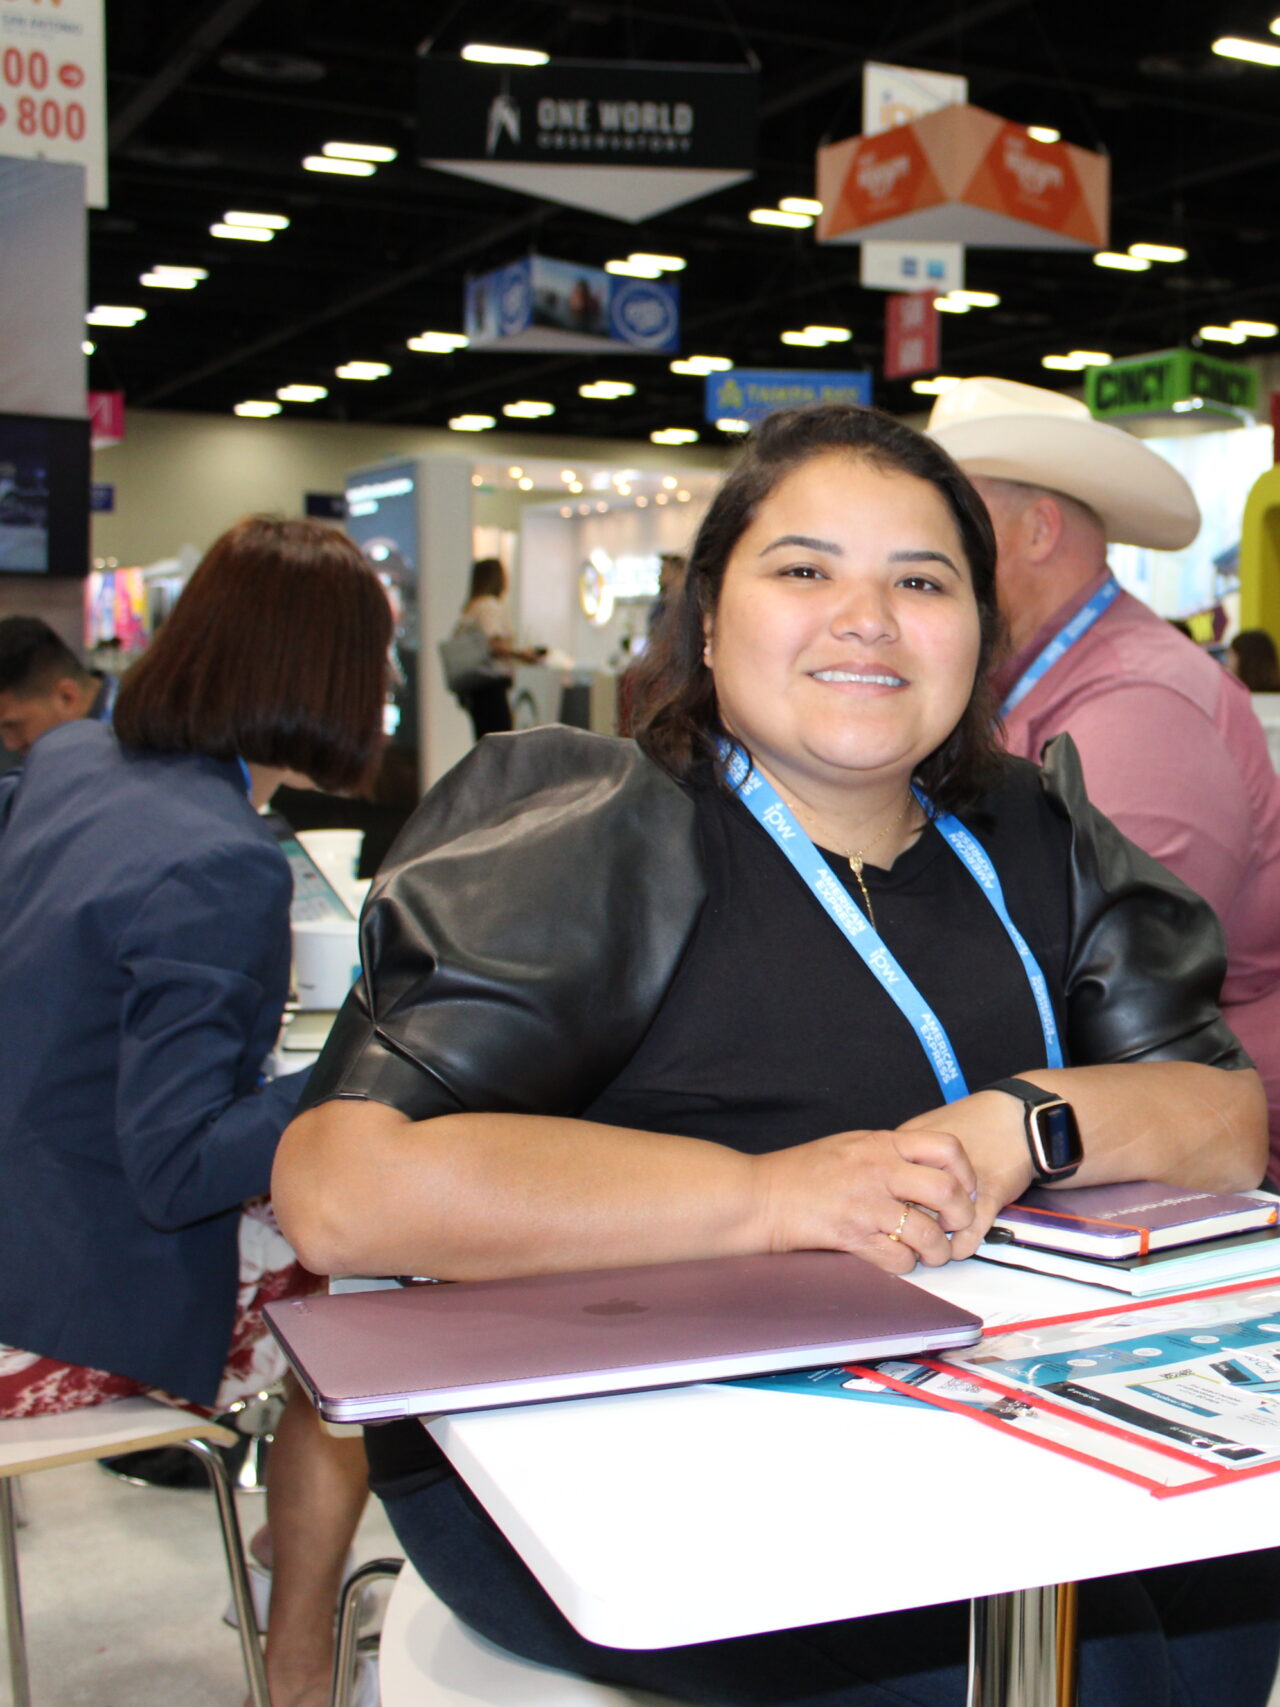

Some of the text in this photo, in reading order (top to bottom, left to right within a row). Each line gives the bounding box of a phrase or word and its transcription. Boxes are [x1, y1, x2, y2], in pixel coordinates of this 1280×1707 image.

[17, 95, 87, 143] 800
[537, 98, 694, 135] ONE WORLD
[762, 802, 797, 840] ipw
[948, 832, 995, 889] AMERICAN
[814, 880, 859, 937] EXPRESS
[816, 868, 868, 933] AMERICAN
[868, 946, 900, 984] ipw
[919, 1025, 950, 1085] EXPRESS
[921, 1012, 959, 1081] AMERICAN
